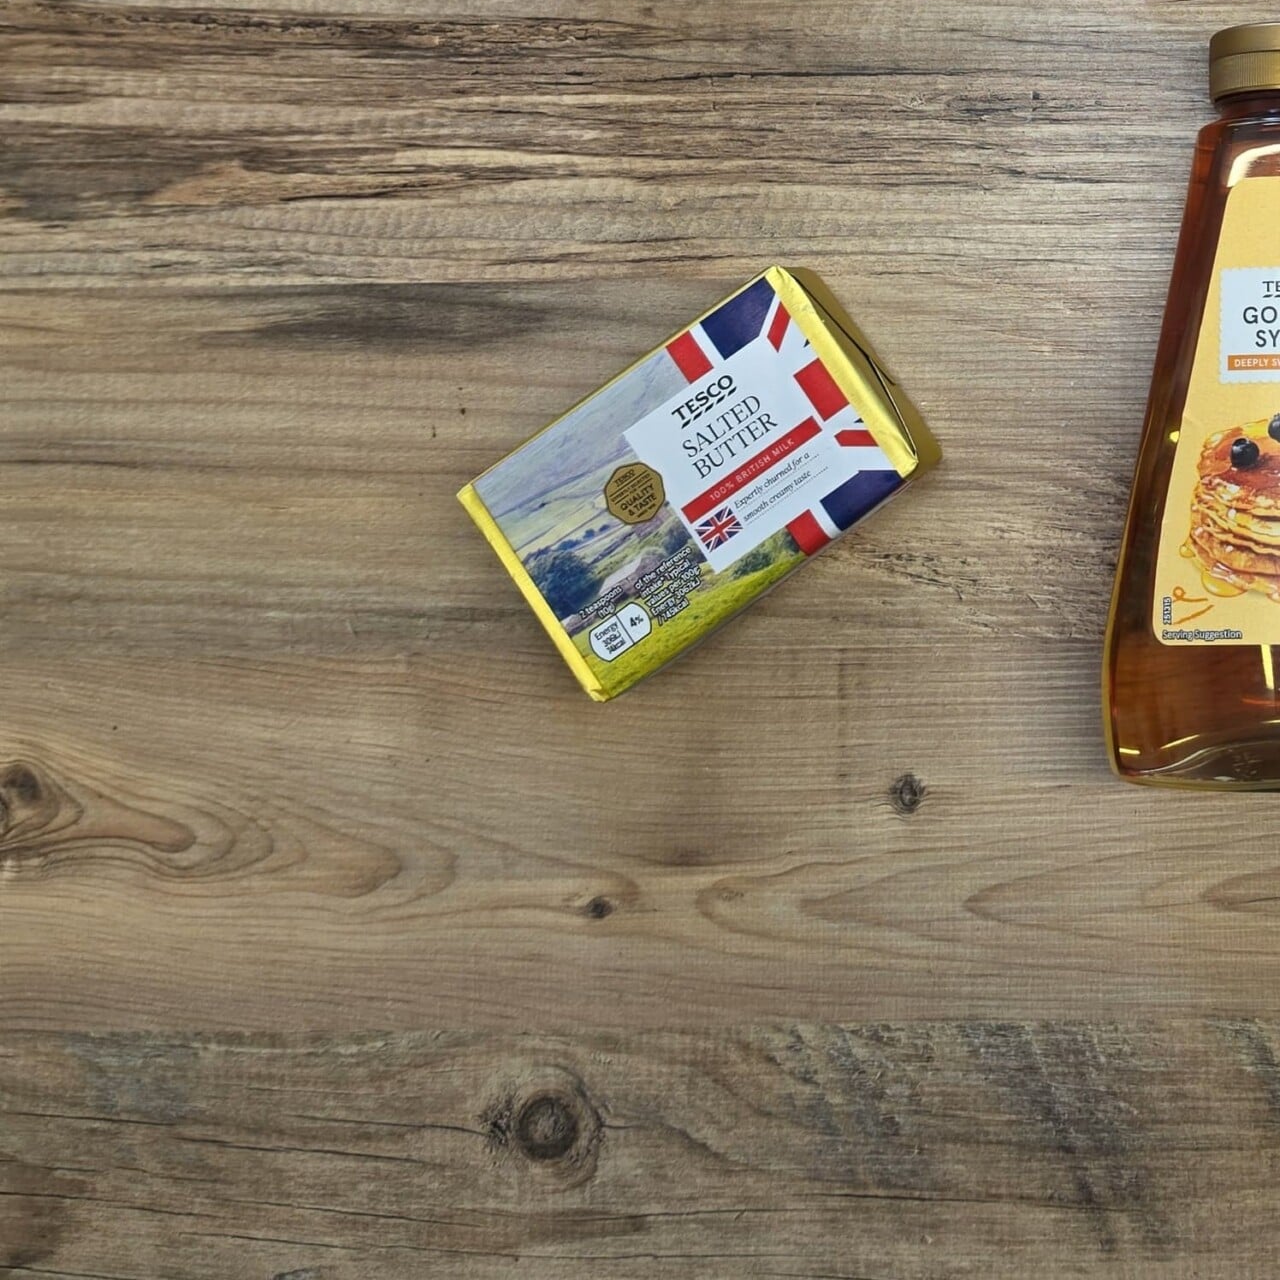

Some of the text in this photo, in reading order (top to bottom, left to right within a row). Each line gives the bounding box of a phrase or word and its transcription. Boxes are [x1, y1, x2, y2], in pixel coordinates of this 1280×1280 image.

[1234, 358, 1269, 368] DEEPLY
[671, 375, 734, 422] TESCO
[682, 395, 761, 458] SALTED
[692, 413, 778, 480] BUTTER
[710, 438, 795, 501] 100% BRITISH MILK
[735, 486, 763, 509] Expertly
[763, 465, 792, 488] churned
[791, 458, 803, 471] for
[620, 484, 655, 511] QUALITY
[634, 495, 657, 511] TASTE
[744, 470, 811, 522] smooth creamy taste
[635, 548, 692, 589] of the reference
[664, 560, 690, 580] Typical
[579, 587, 622, 619] 2 teaspoons
[647, 579, 681, 606] values per
[651, 578, 700, 615] Energy 3062kJ
[630, 615, 644, 627] 4%
[663, 599, 689, 622] 745kcal
[594, 622, 619, 641] Energy
[1162, 630, 1243, 641] Serving Suggestion
